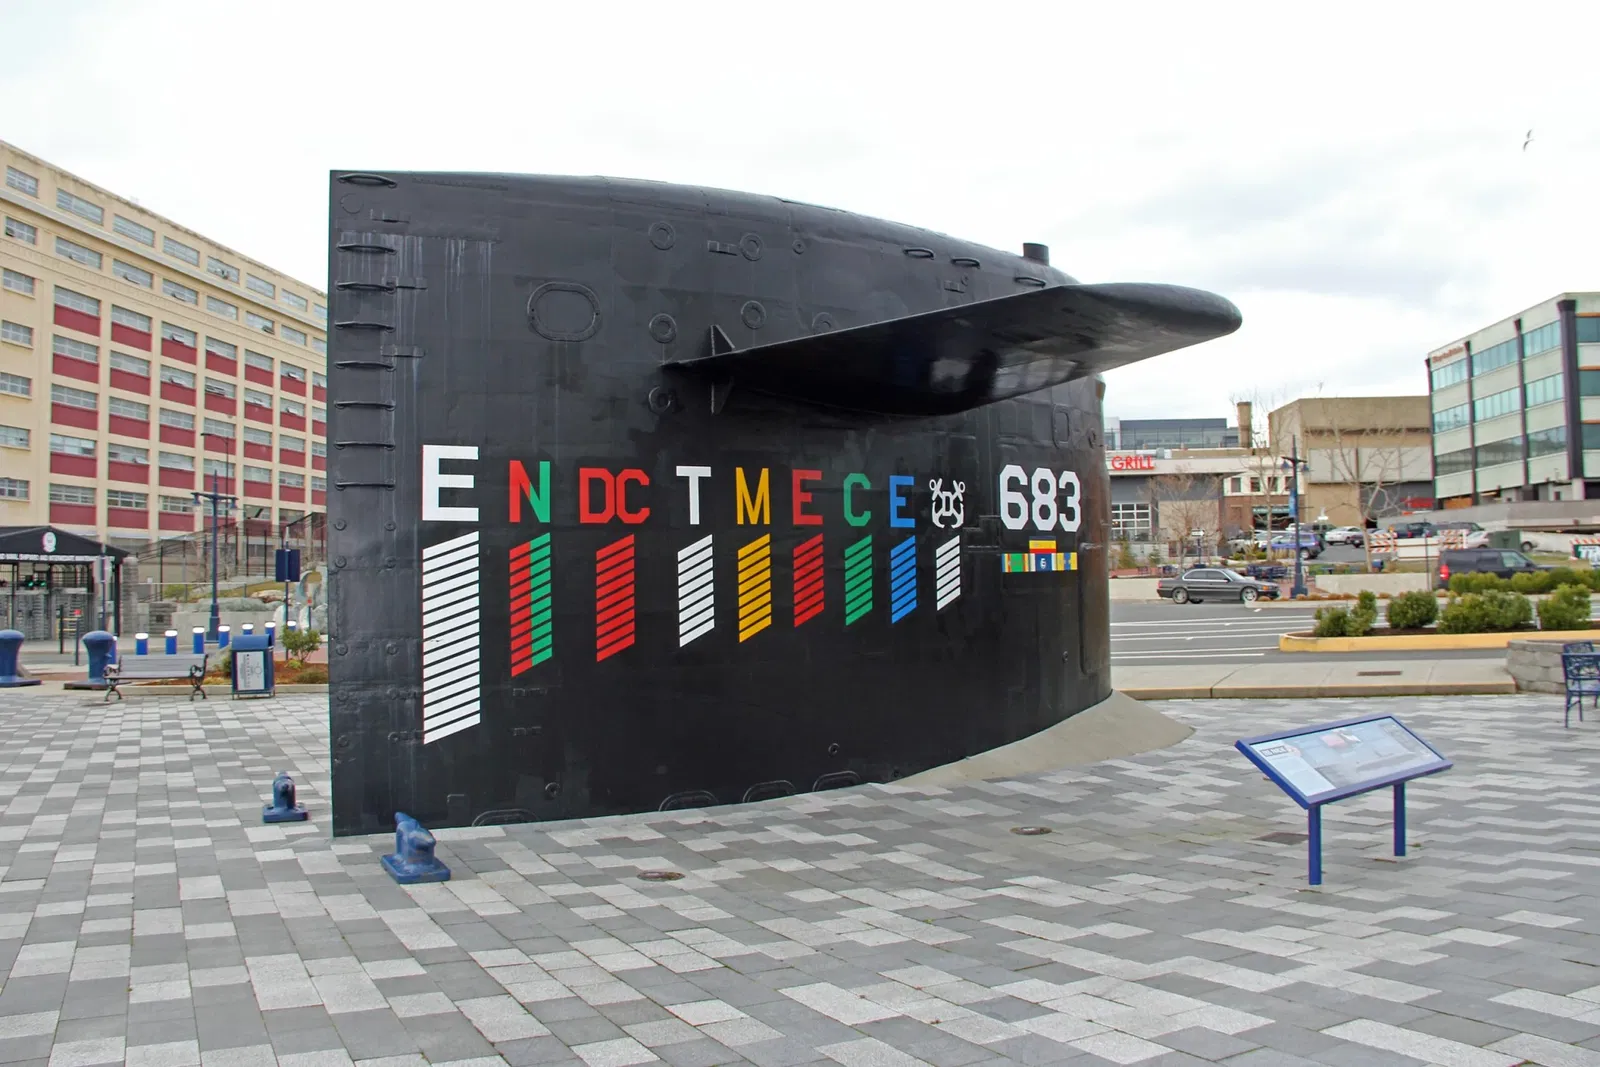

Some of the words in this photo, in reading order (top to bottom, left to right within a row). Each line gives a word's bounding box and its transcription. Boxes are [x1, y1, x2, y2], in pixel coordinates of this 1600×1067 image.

[422, 444, 478, 521] E
[508, 460, 550, 523] N
[579, 467, 650, 524] DC
[676, 465, 712, 525] T
[735, 467, 770, 525] M
[792, 469, 823, 525] E
[843, 473, 872, 527] C
[889, 475, 916, 528] E
[1111, 455, 1155, 471] GRILL
[1000, 464, 1081, 532] 683
